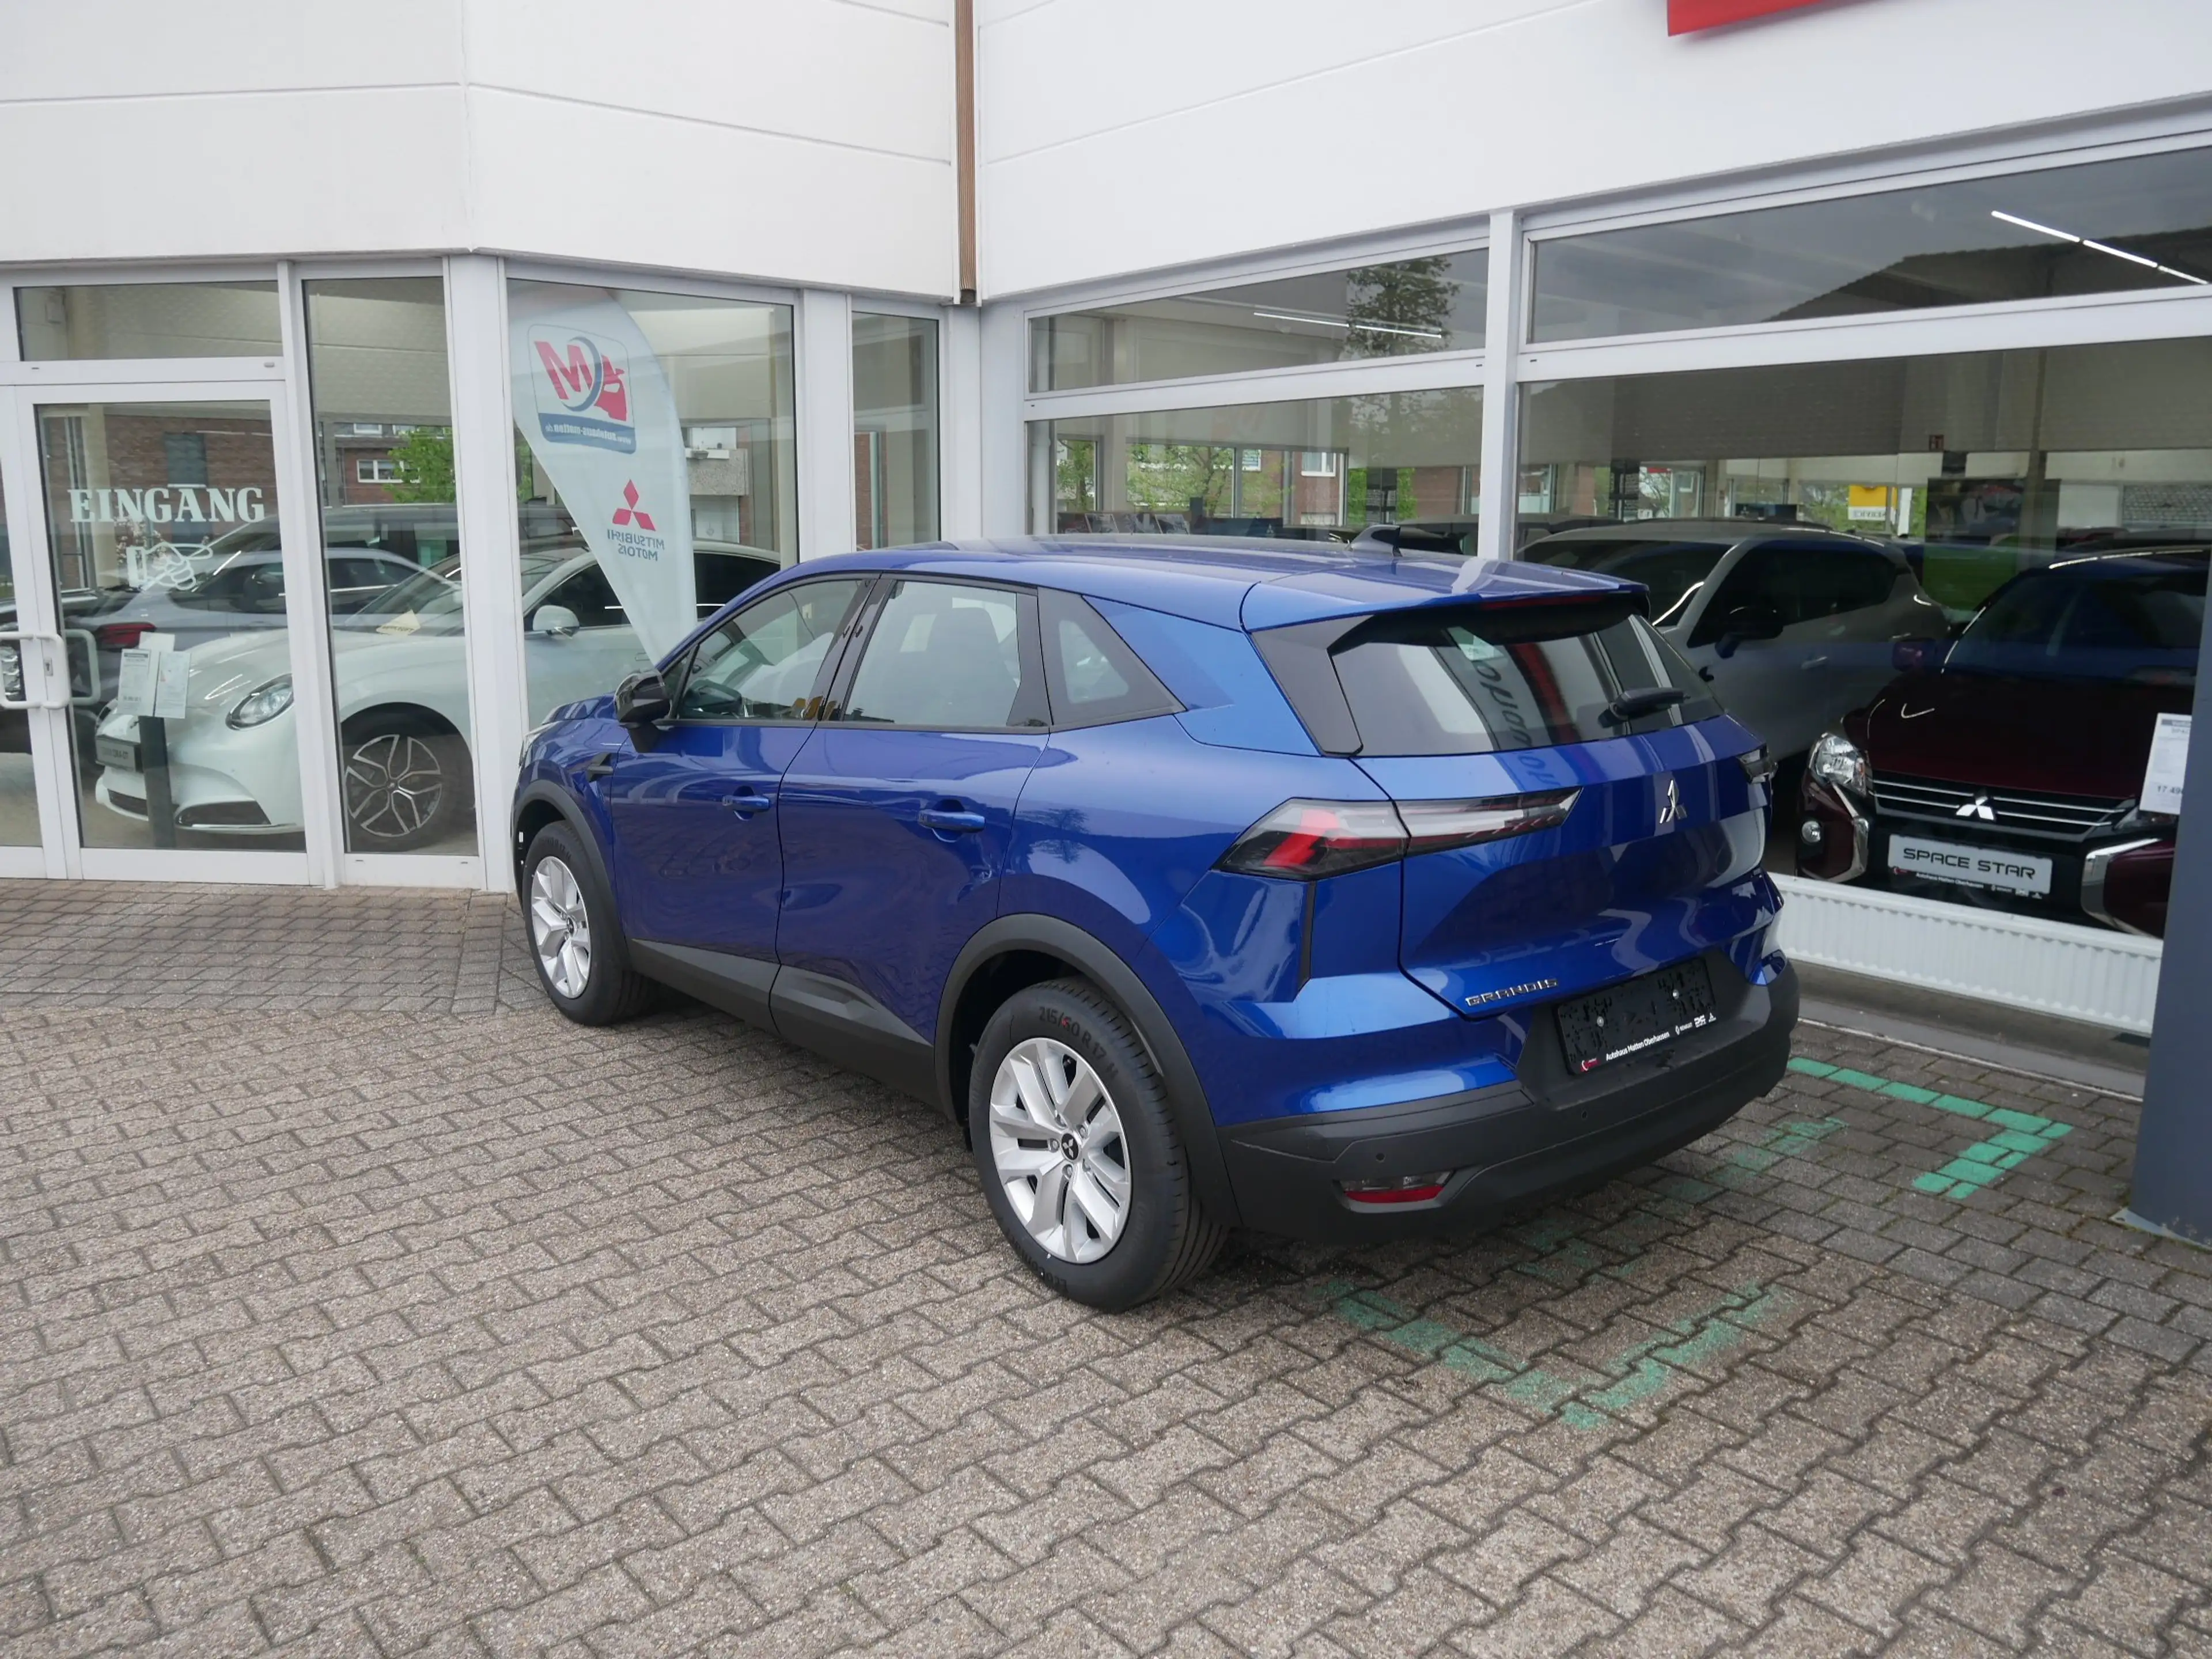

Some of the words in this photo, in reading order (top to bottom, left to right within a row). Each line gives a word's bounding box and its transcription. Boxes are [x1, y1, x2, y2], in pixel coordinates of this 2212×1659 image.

[67, 487, 265, 522] EINGANG
[1903, 848, 1970, 869] SPACE
[1978, 859, 2035, 880] STAR
[1465, 979, 1558, 1006] GRANDIS
[1081, 1030, 1092, 1048] R
[1606, 1048, 1628, 1061] Autohaus
[1643, 1032, 1670, 1047] Oberhausen
